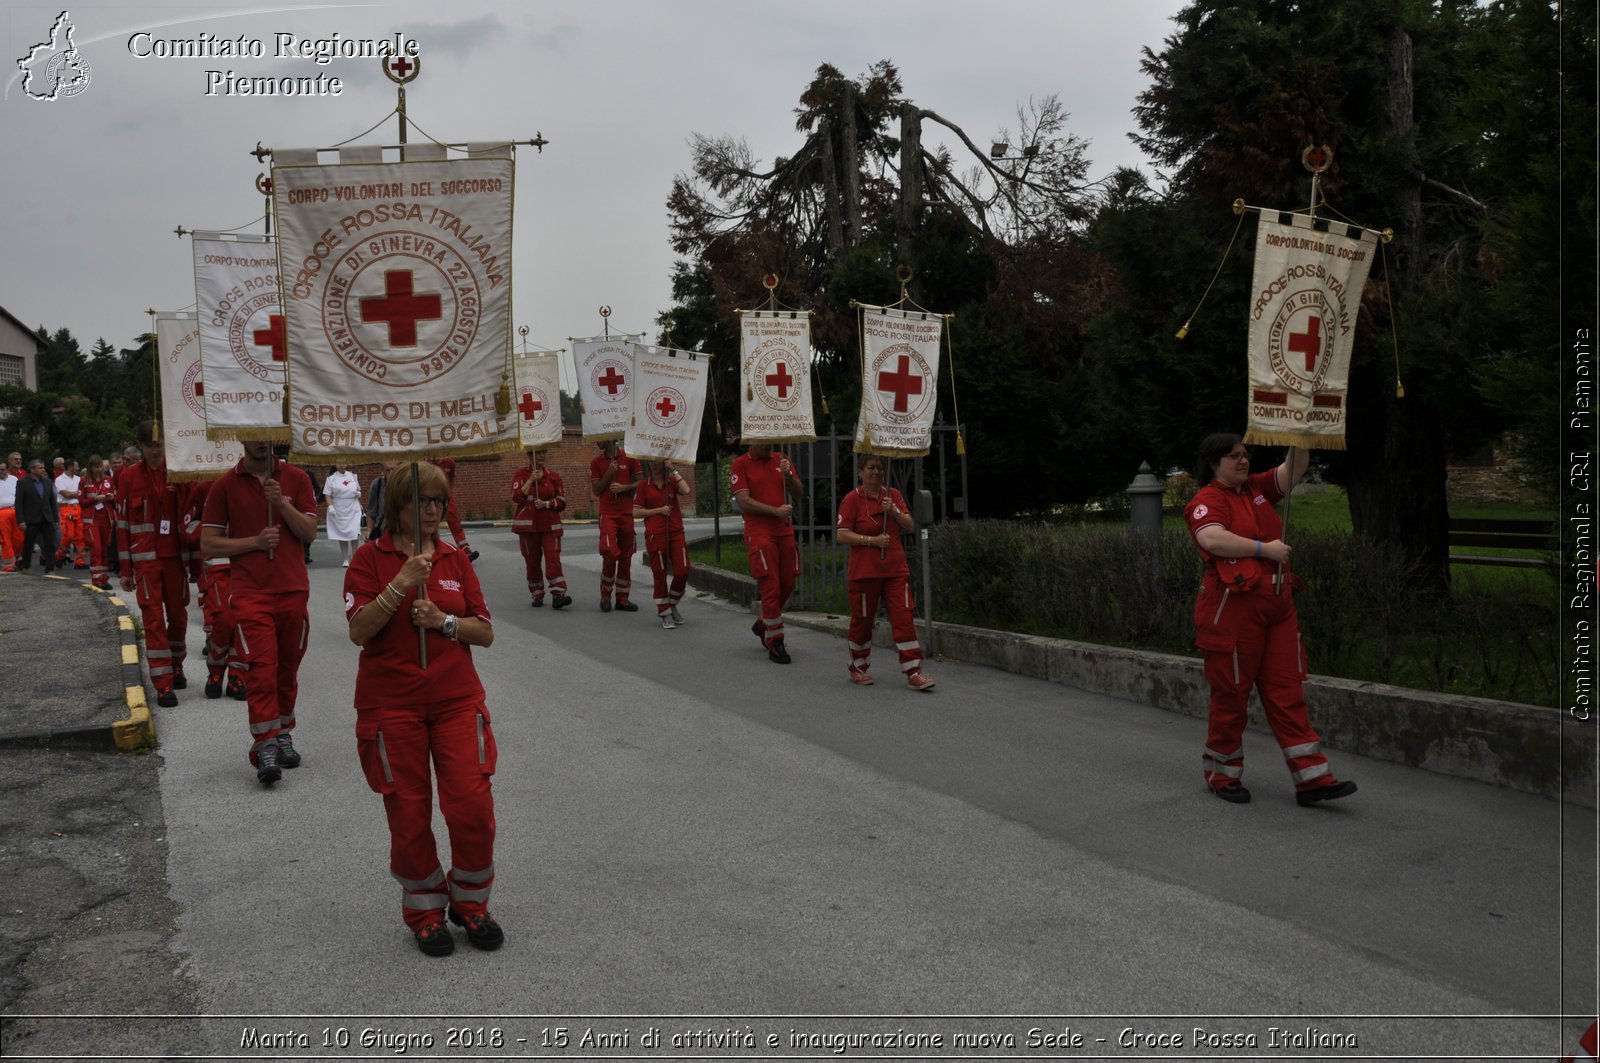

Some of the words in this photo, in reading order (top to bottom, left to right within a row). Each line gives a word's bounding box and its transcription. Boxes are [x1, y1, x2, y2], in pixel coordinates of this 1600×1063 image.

[288, 187, 329, 205] CORPO
[334, 182, 403, 201] VOLONTARI
[411, 181, 435, 197] DEL
[441, 178, 502, 196] SOCCORSO
[292, 228, 342, 300] CROCE
[340, 202, 423, 236] ROSSA
[428, 207, 503, 290] ITALIANA
[368, 235, 447, 265] GINEVRA
[1266, 233, 1291, 248] CORPO
[1325, 243, 1335, 256] DEL
[204, 254, 232, 266] CORPO
[345, 252, 364, 271] DI
[446, 262, 468, 284] 22
[1253, 275, 1288, 321] CROCE
[1287, 264, 1326, 282] ROSSA
[211, 286, 244, 328] CROCE
[240, 305, 253, 316] DI
[451, 287, 476, 347] AGOSTO
[1286, 299, 1296, 312] DI
[325, 275, 388, 379] CONVENZIONE
[866, 317, 884, 327] CORPO
[1326, 318, 1335, 332] 22
[169, 334, 194, 364] CROCE
[230, 315, 268, 379] CONVENZIONE
[872, 343, 909, 371] CONVENZIONE
[911, 350, 931, 376] GINEVRA
[1271, 312, 1303, 391] CONVENZIONE
[420, 345, 459, 377] 1864
[742, 346, 763, 376] CROCE
[211, 392, 264, 404] GRUPPO
[269, 391, 281, 402] DI
[300, 402, 399, 423] GRUPPO
[409, 401, 431, 420] DI
[1253, 405, 1304, 421] COMITATO
[302, 427, 414, 447] COMITATO
[427, 417, 507, 445] LOCALE
[743, 423, 771, 431] BORGO
[782, 423, 812, 431] DALMAZZO
[215, 441, 225, 449] DI
[878, 435, 925, 447] RACCONIGI
